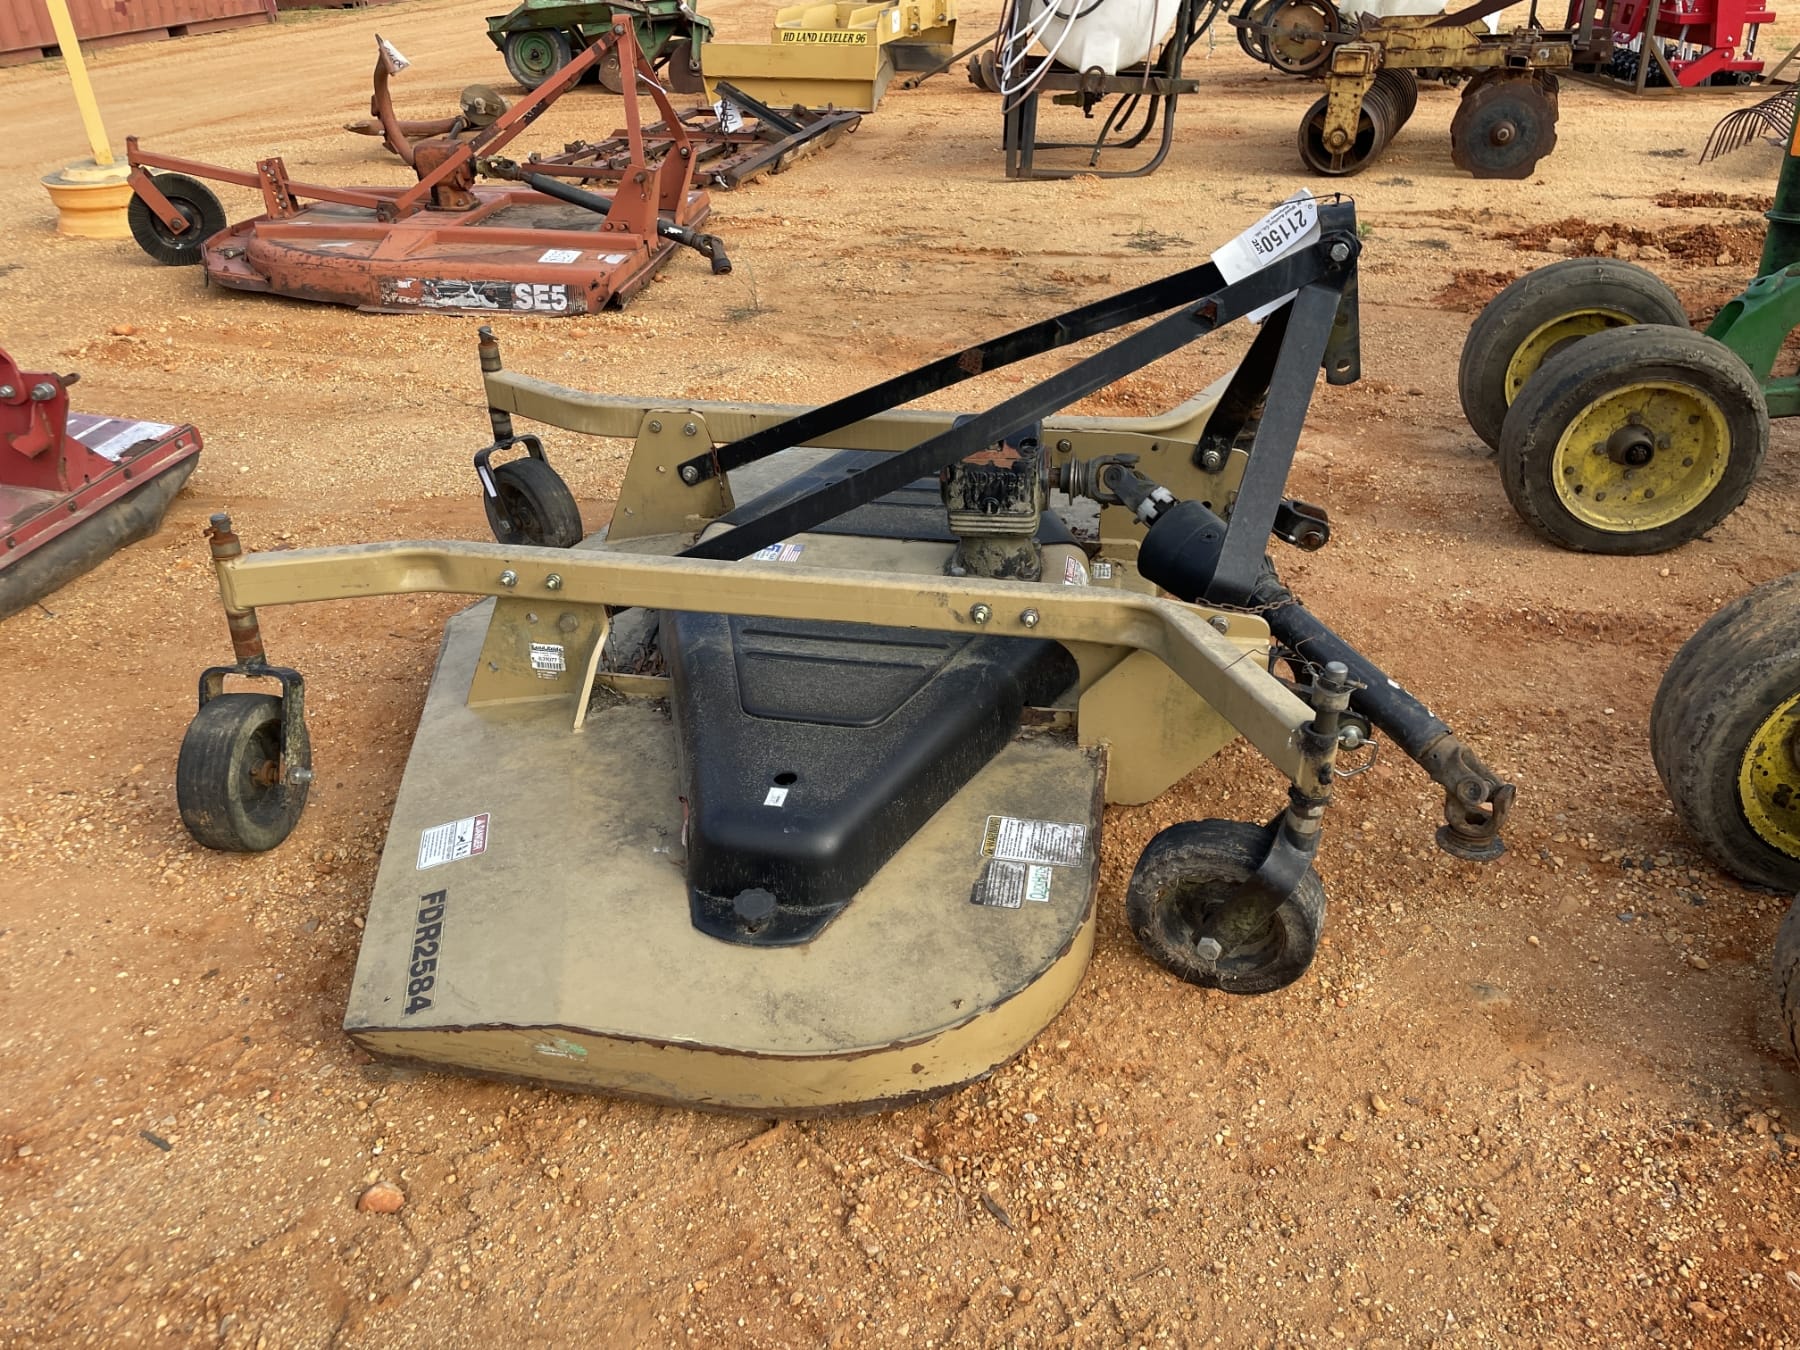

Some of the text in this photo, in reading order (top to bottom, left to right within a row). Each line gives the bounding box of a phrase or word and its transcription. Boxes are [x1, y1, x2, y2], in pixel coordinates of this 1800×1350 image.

[783, 32, 866, 43] HD LAND LEVELER 96
[1262, 210, 1307, 253] 21150
[514, 283, 568, 311] SE5
[986, 819, 1000, 847] WARNING
[405, 889, 448, 1015] FDR2584
